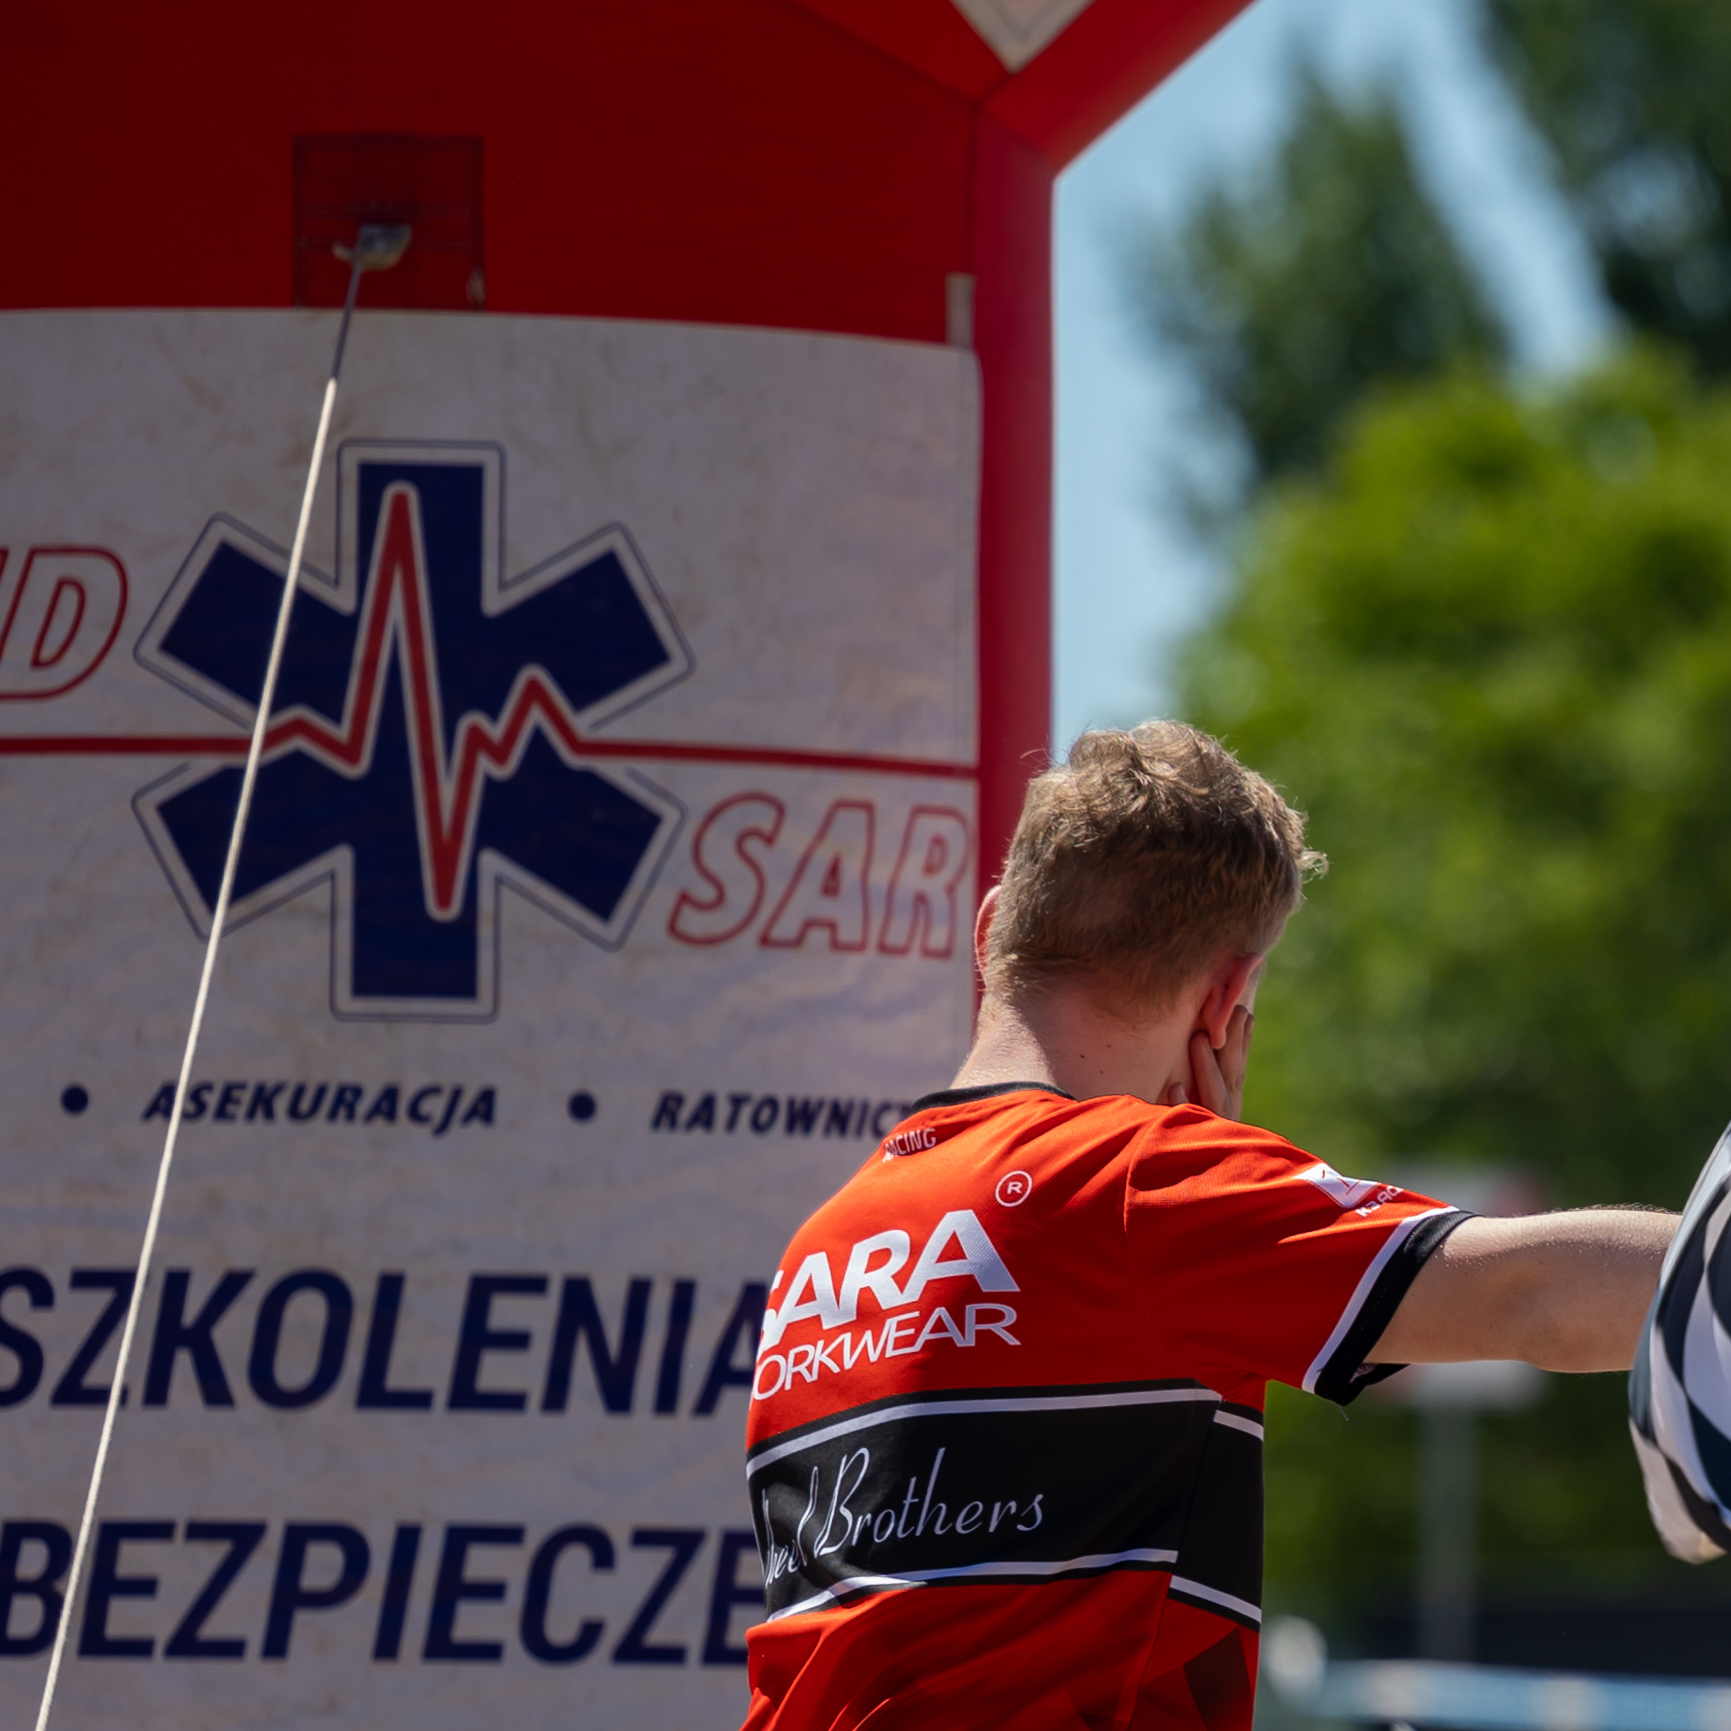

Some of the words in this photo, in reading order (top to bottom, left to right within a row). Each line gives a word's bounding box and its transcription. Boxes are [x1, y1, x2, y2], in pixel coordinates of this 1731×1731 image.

[0, 545, 128, 702] D
[667, 791, 970, 960] SAR
[141, 1080, 500, 1138] ASEKURACJA
[0, 1264, 772, 1417] SZKOLENIA
[813, 1447, 1044, 1560] Brothers
[0, 1519, 768, 1666] BEZPIECZE
